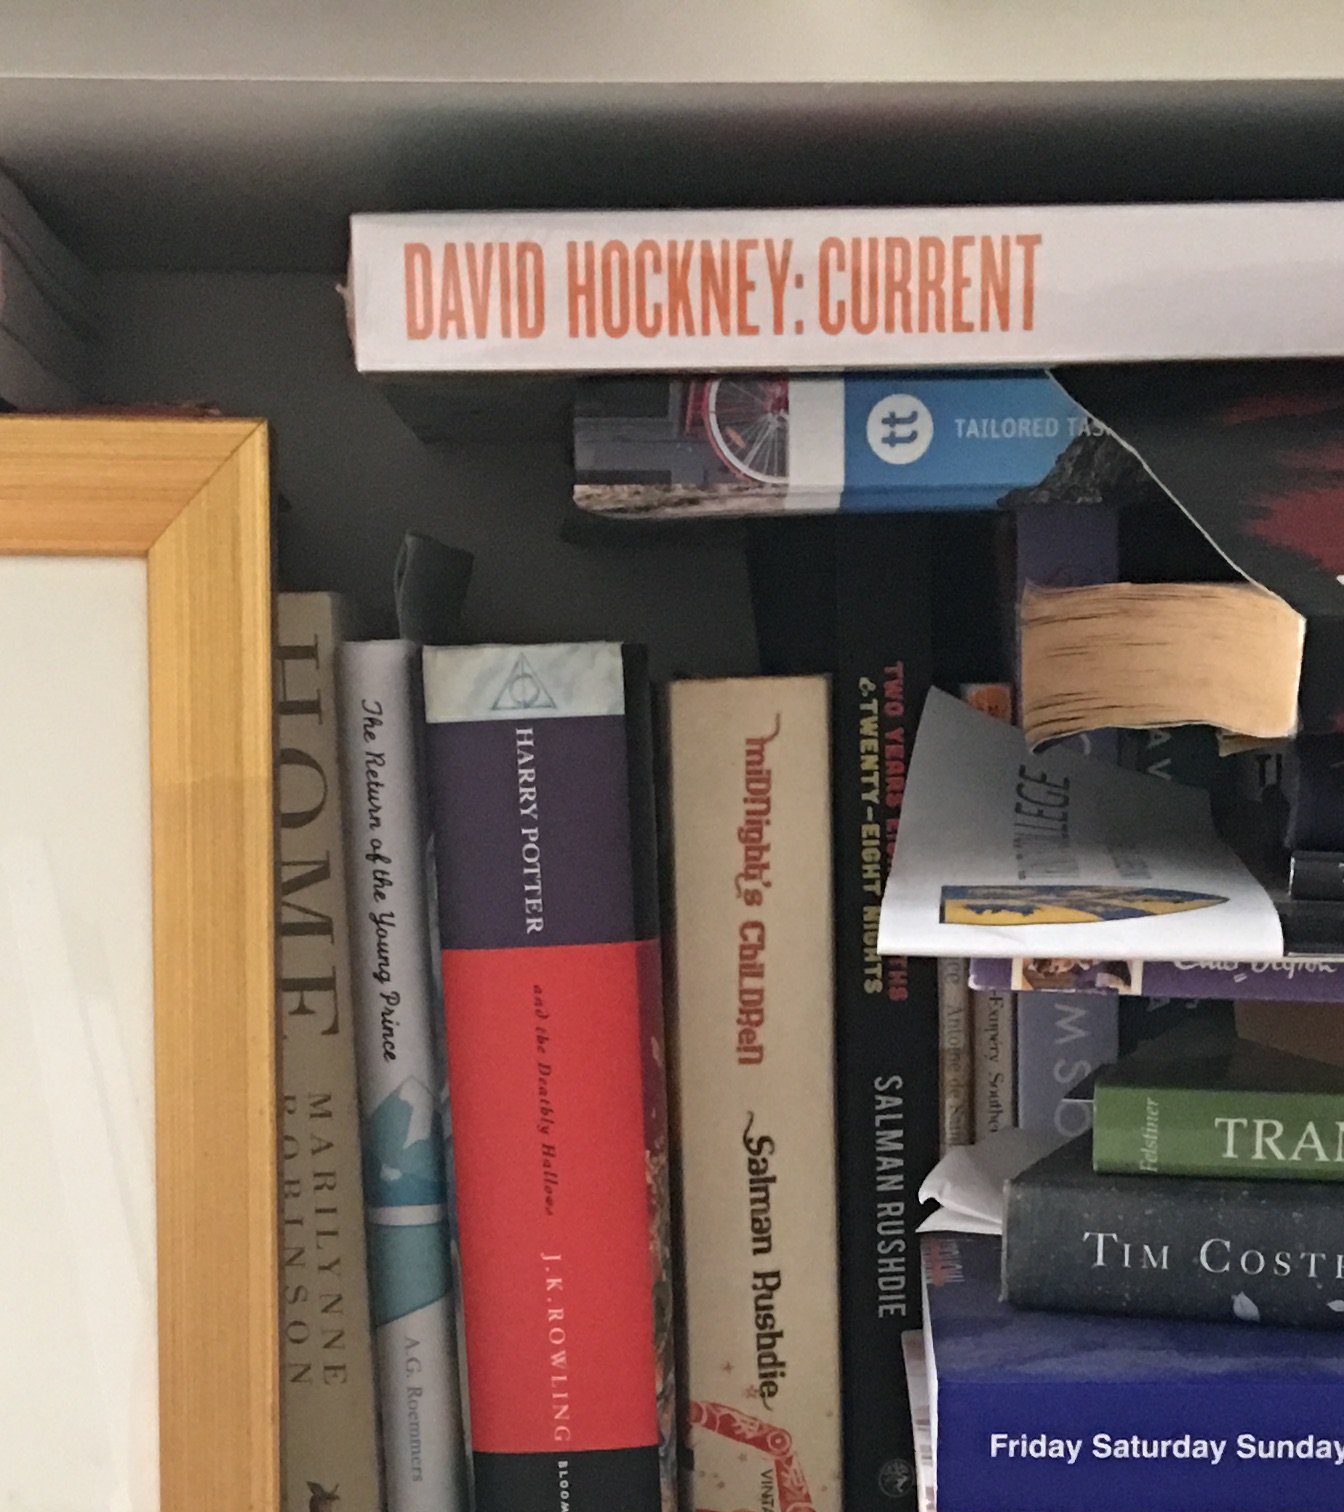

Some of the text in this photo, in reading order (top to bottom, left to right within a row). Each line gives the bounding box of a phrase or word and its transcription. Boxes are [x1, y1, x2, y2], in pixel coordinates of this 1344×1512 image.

[403, 233, 1043, 342] DAVID HOCKNEY: CURRENT
[955, 417, 1059, 440] TAILORED
[883, 661, 905, 718] TWO
[515, 727, 545, 934] HARRY POTTER
[364, 749, 401, 1064] Return Prince
[873, 1075, 907, 1318] SALMAN RUSHDIE
[407, 1386, 424, 1484] Roemmers
[989, 1433, 1084, 1465] Friday
[1091, 1433, 1228, 1465] Saturday
